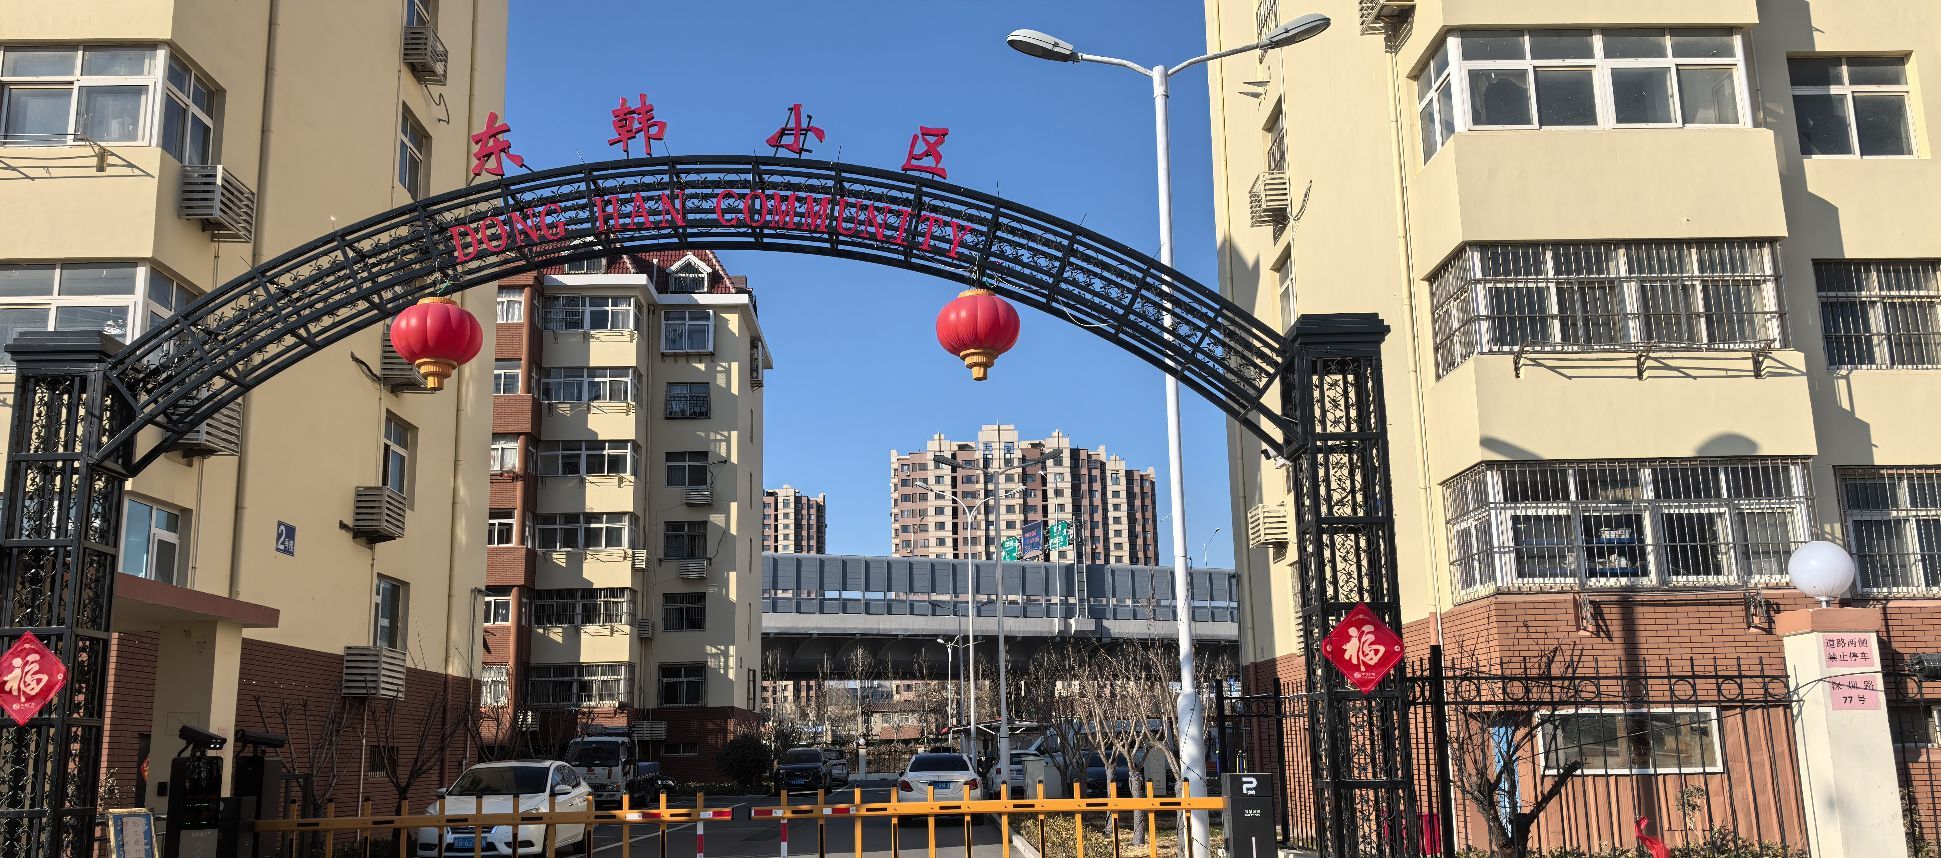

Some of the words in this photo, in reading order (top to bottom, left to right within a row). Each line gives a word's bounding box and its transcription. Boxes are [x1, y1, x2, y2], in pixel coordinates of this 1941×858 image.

[471, 93, 949, 179] 东韩小区
[449, 203, 567, 263] DONG
[592, 190, 686, 233] HAN
[715, 189, 974, 259] COMMUNITY
[1341, 624, 1386, 672] 福
[1826, 638, 1868, 648] 道路两侧
[1828, 652, 1870, 662] 禁止停车
[3, 653, 48, 703] 福
